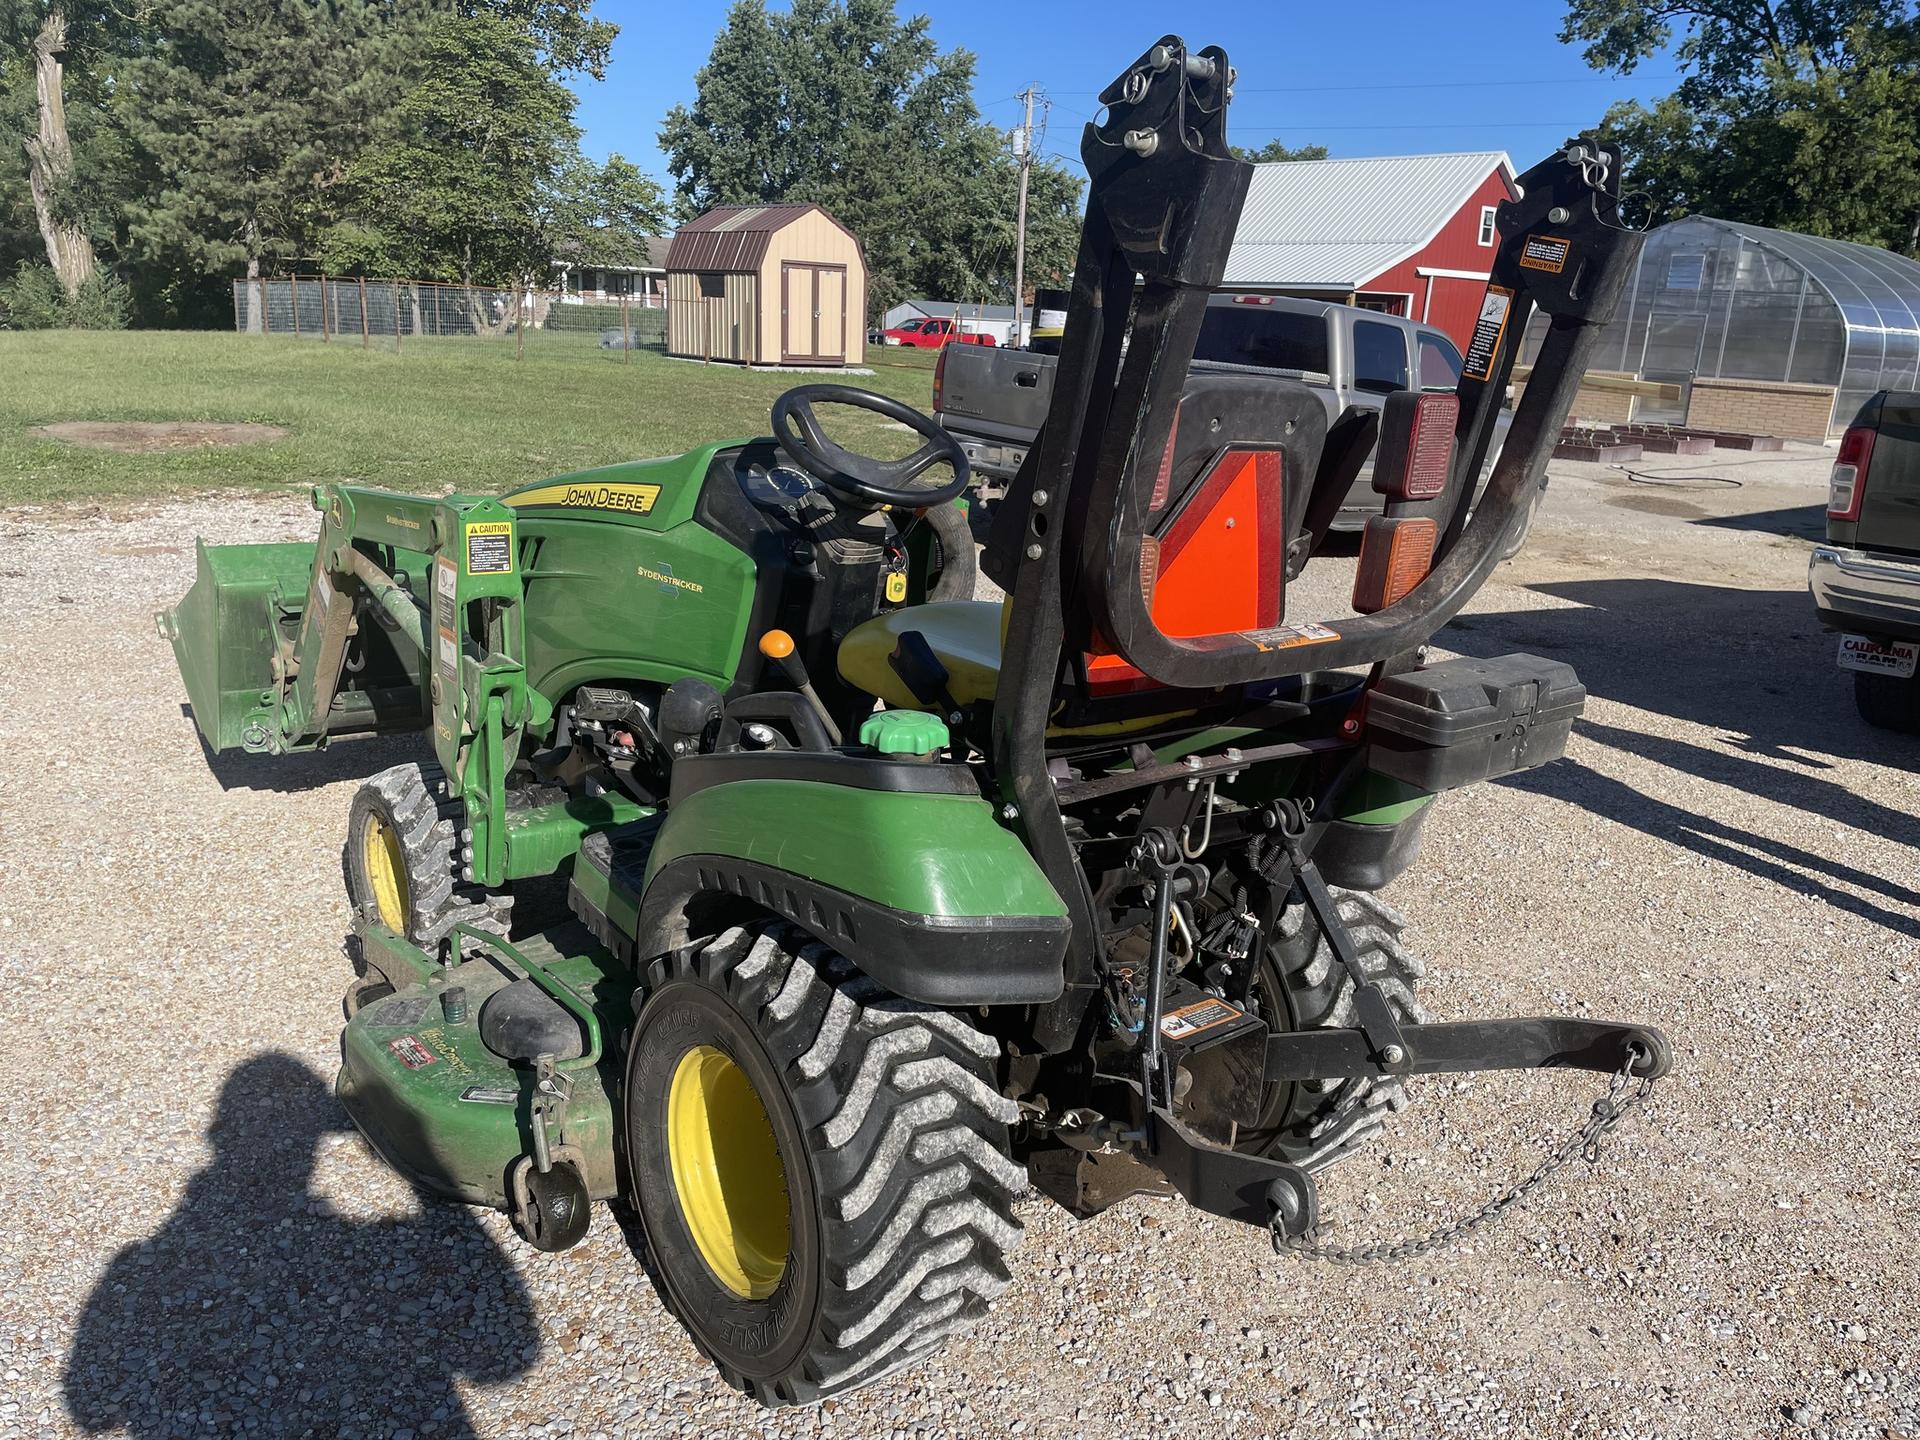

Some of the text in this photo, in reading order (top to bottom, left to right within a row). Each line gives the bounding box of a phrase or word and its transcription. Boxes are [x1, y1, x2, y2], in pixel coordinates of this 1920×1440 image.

[1522, 258, 1554, 271] WARNING
[561, 487, 645, 511] JOHN DEERE
[479, 524, 510, 534] CAUTION
[637, 566, 703, 594] SYDENSTRICKER
[1856, 652, 1898, 664] RAM
